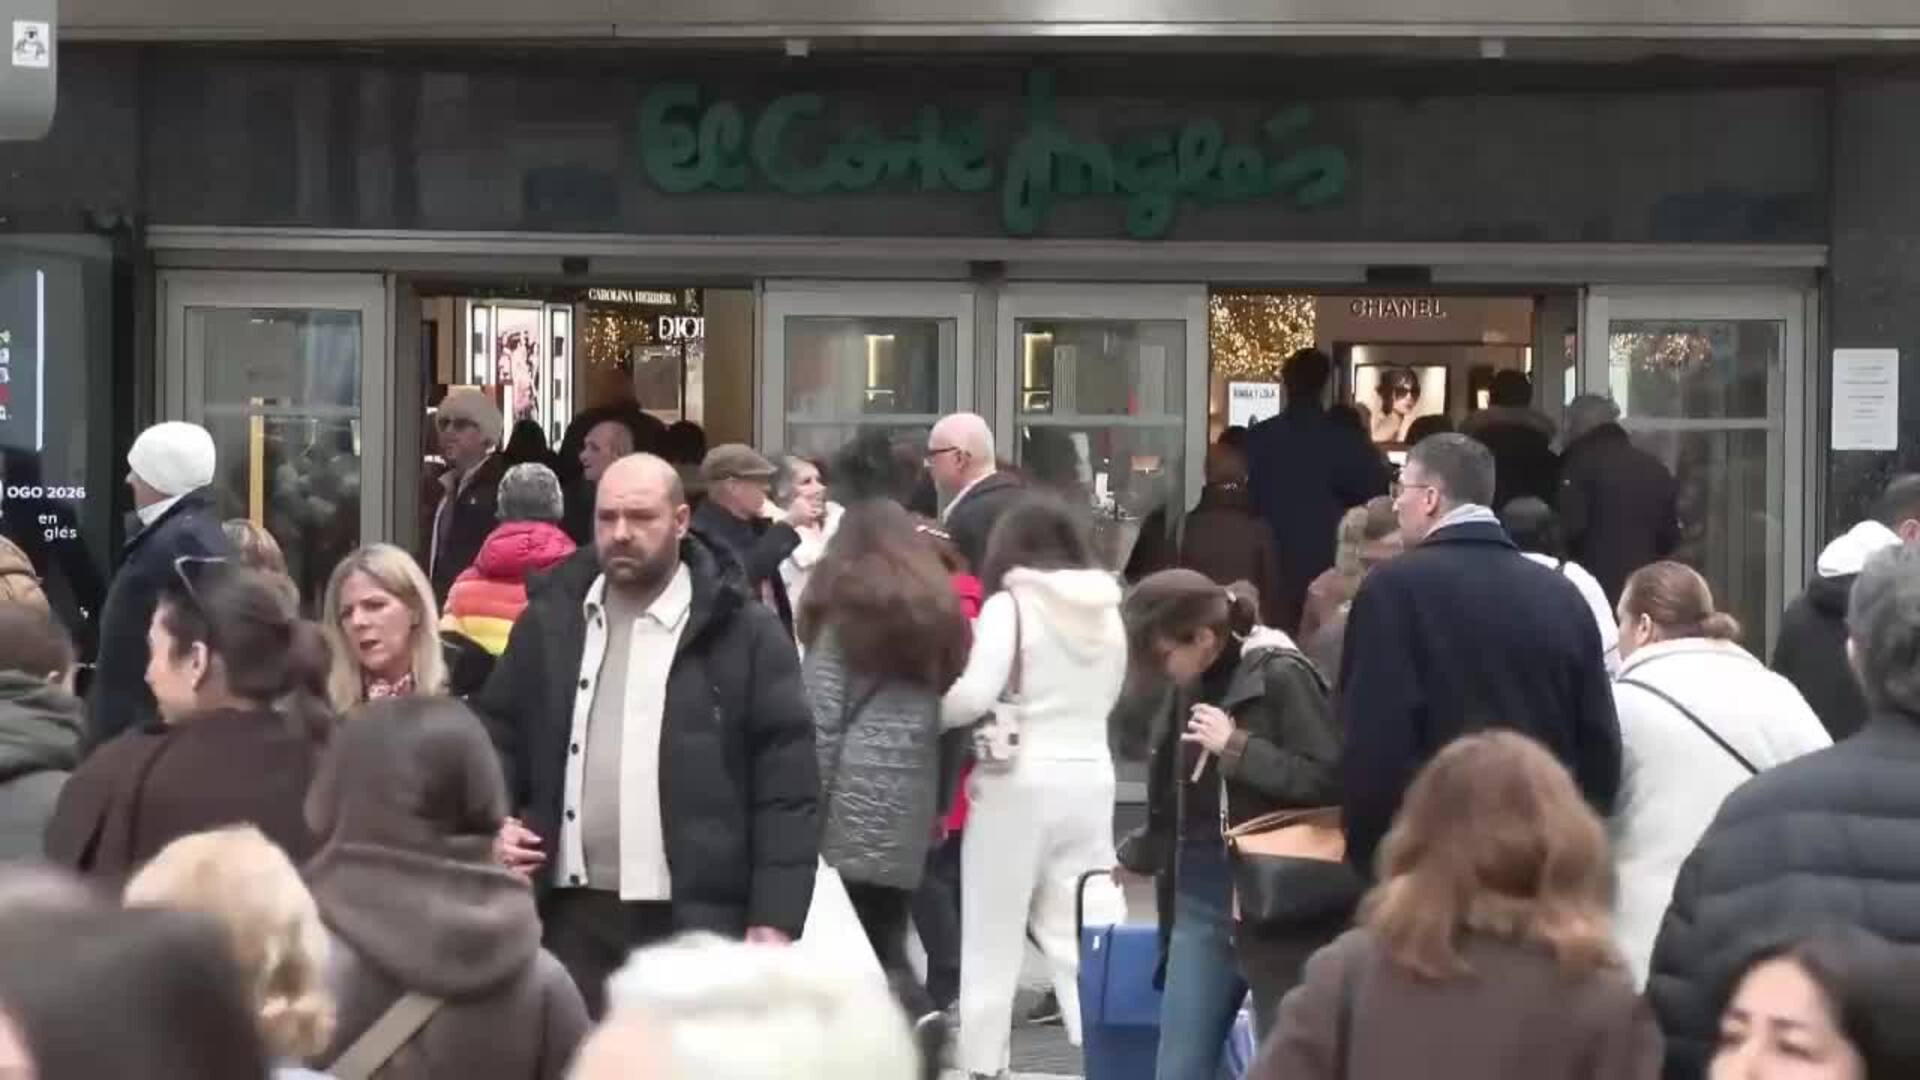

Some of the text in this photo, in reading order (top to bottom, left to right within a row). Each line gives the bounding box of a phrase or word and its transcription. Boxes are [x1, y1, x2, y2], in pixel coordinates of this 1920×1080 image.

[639, 70, 1347, 238] El Corte Inglés
[588, 288, 678, 305] CAROLINA HERRERA
[1351, 297, 1447, 319] CHANEL
[46, 486, 86, 499] 2026
[38, 513, 58, 524] en
